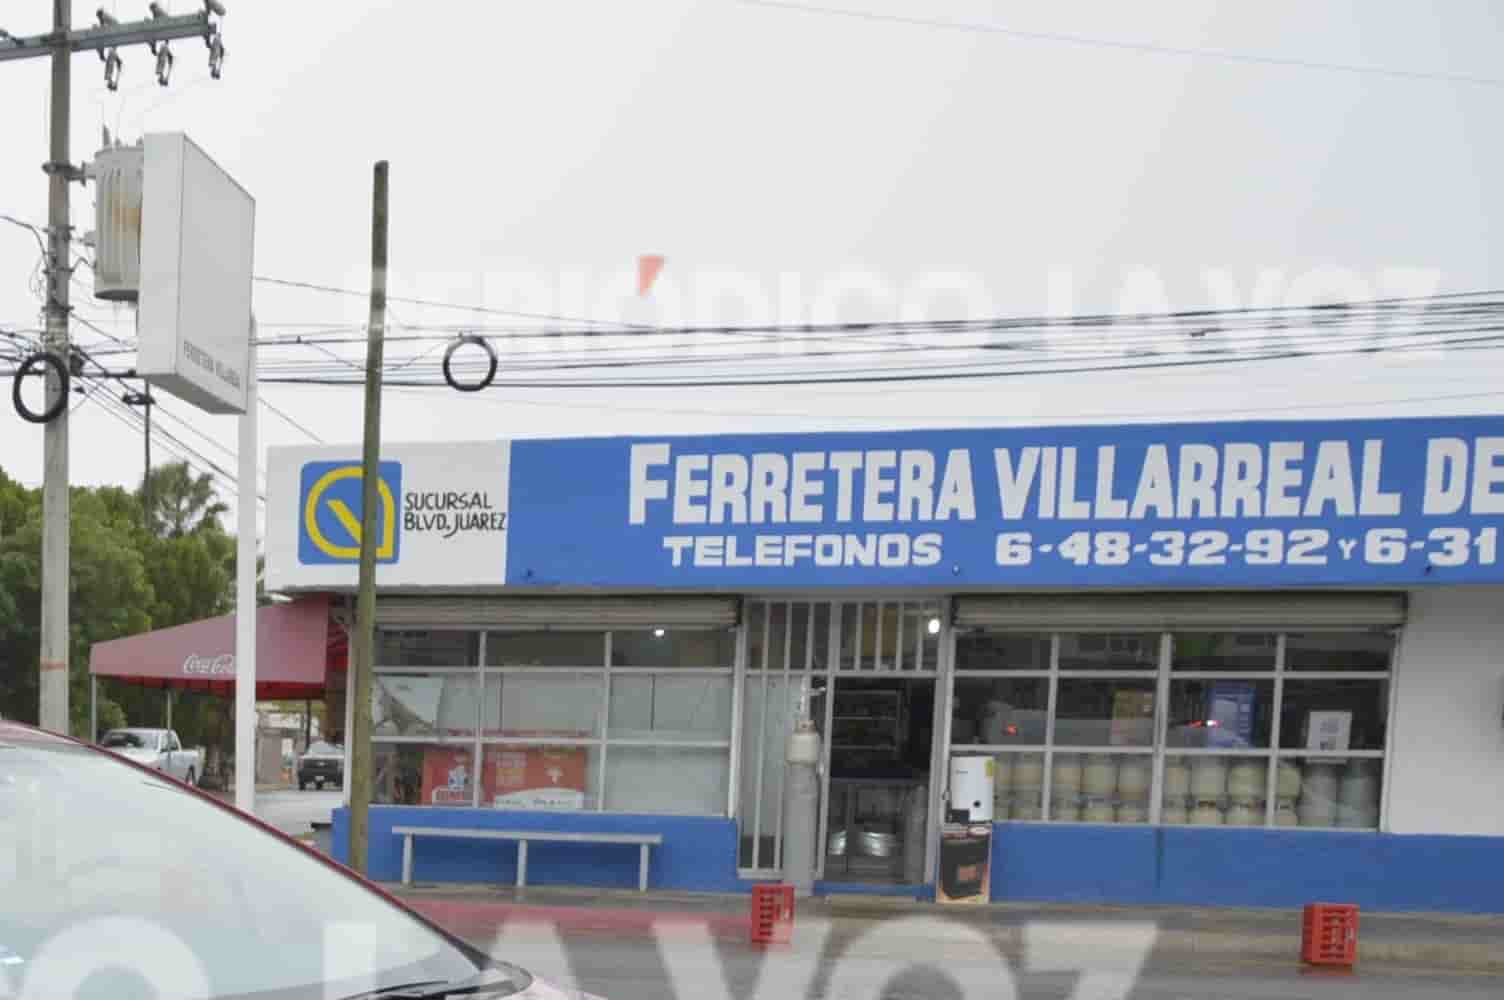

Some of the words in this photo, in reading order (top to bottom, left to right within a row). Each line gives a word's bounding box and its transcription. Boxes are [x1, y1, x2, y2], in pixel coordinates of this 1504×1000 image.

[628, 442, 977, 526] FERRETERA
[993, 439, 1402, 521] VILLARREAL
[1422, 436, 1504, 516] DE
[404, 491, 493, 511] SUCURSAL
[442, 511, 507, 539] JUAREZ
[662, 532, 943, 568] TELEFONOS
[995, 528, 1330, 567] 6-48-32-92
[1364, 527, 1497, 567] 6-31
